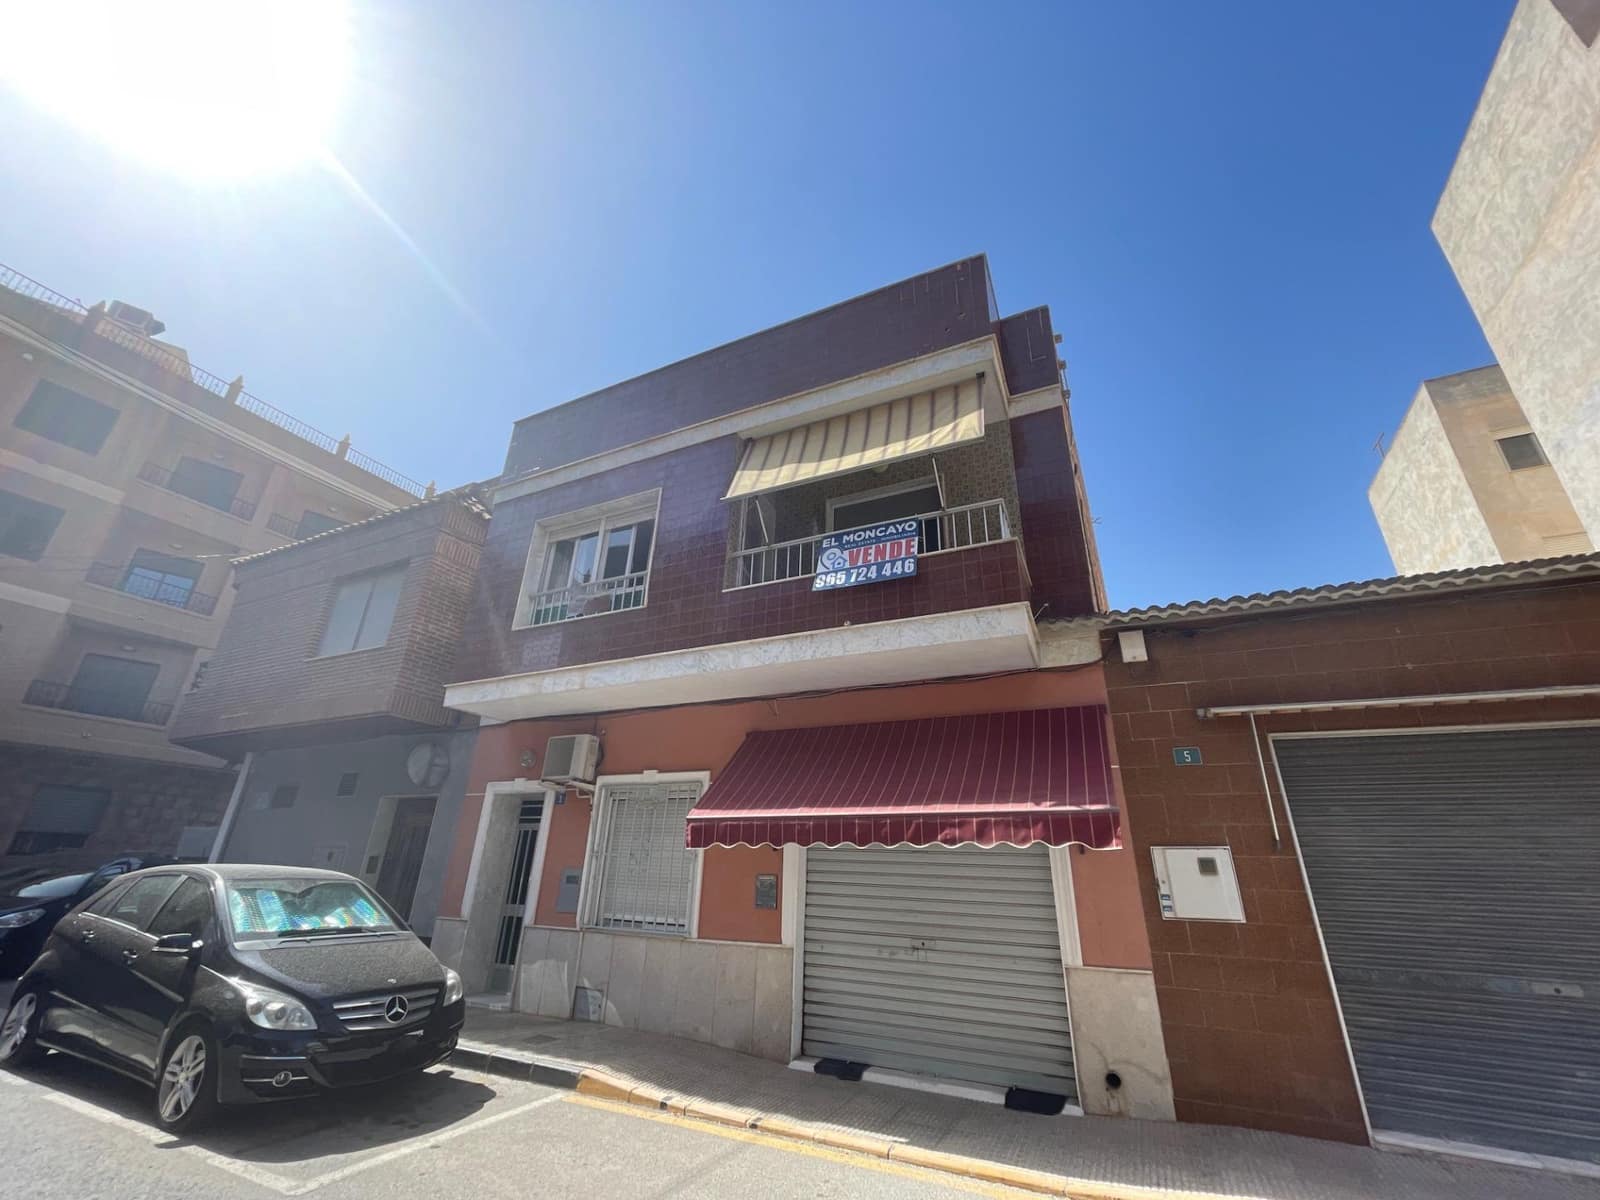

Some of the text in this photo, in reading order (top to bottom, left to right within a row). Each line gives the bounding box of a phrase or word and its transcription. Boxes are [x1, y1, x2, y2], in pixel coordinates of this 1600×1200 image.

[823, 537, 839, 548] EL
[843, 521, 917, 544] MONCAYO
[848, 538, 915, 567] VENDE
[815, 558, 915, 588] 965 724 446
[1183, 750, 1191, 762] 5
